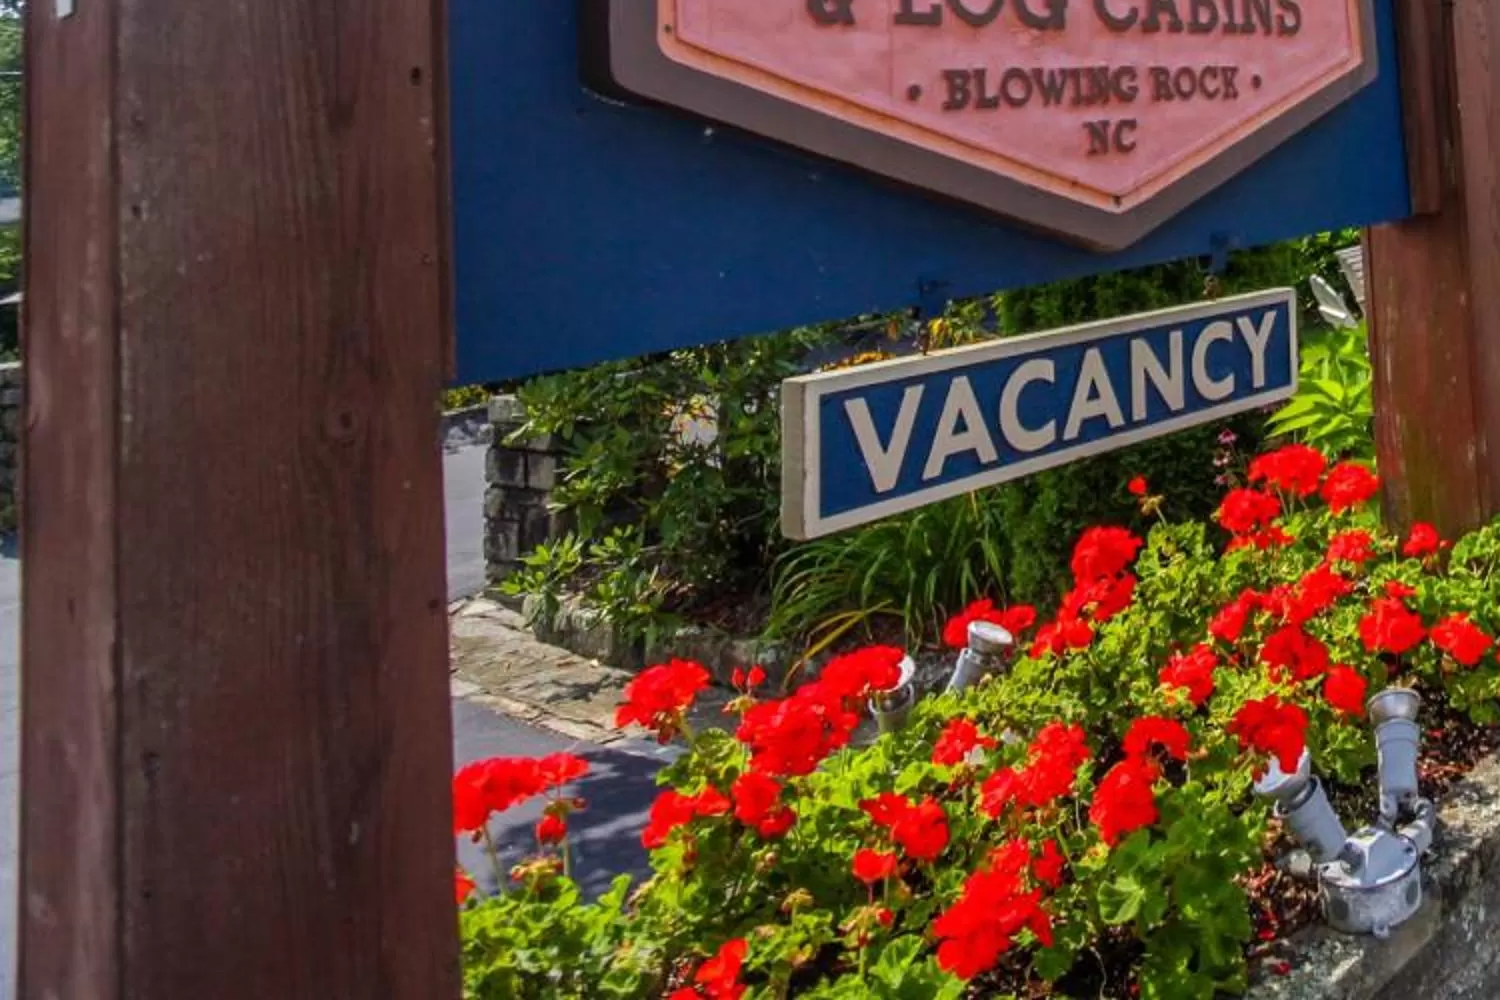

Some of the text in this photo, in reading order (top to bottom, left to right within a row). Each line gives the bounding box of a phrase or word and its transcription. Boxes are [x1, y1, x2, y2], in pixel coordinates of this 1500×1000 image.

[942, 65, 1240, 112] BLOWING ROCK
[1082, 118, 1138, 157] NC
[842, 310, 1279, 494] VACANCY
